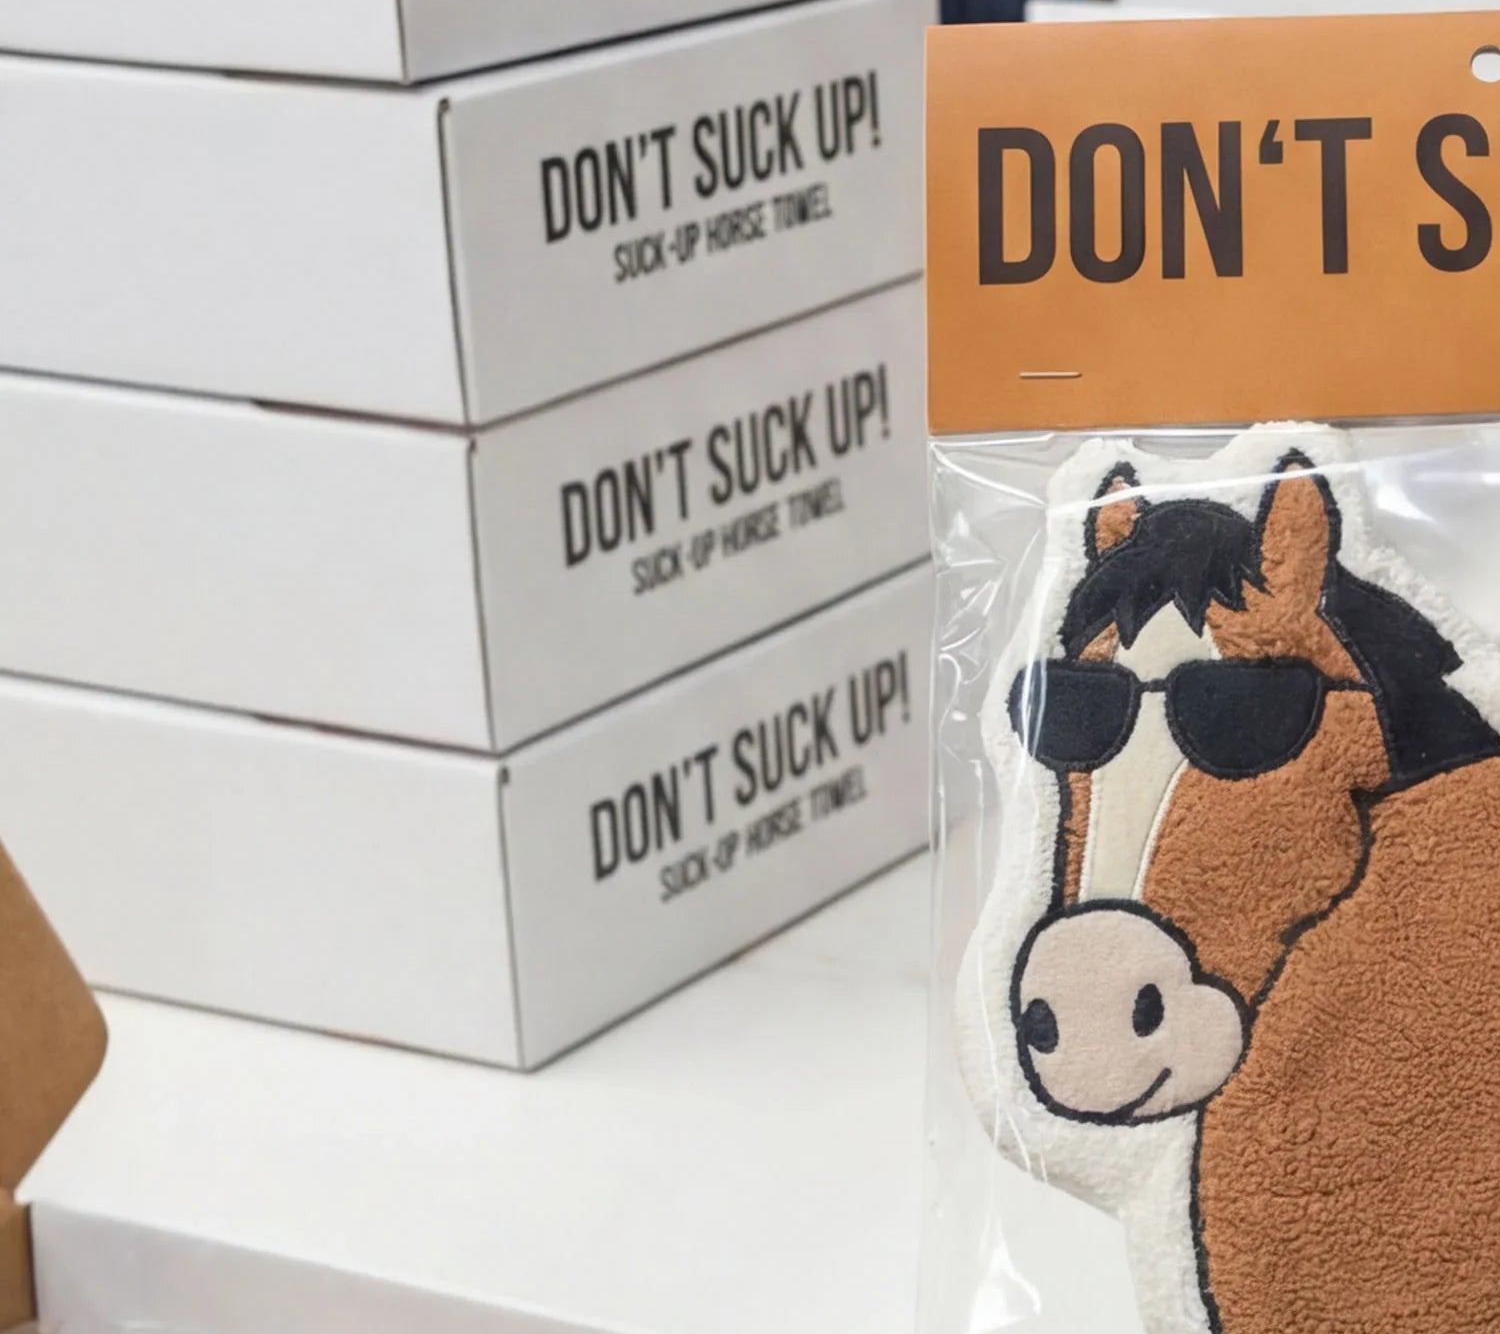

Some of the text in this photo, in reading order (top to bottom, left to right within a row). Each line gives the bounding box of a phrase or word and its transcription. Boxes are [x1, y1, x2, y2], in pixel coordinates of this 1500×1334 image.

[541, 70, 881, 244] DON'T SUCK UP!
[614, 183, 832, 284] SUCK-UP HORSE TOWEL
[560, 363, 889, 566] DON'T SUCK UP!
[722, 508, 780, 556] HORSE
[590, 650, 909, 881] DON'T SUCK UP!
